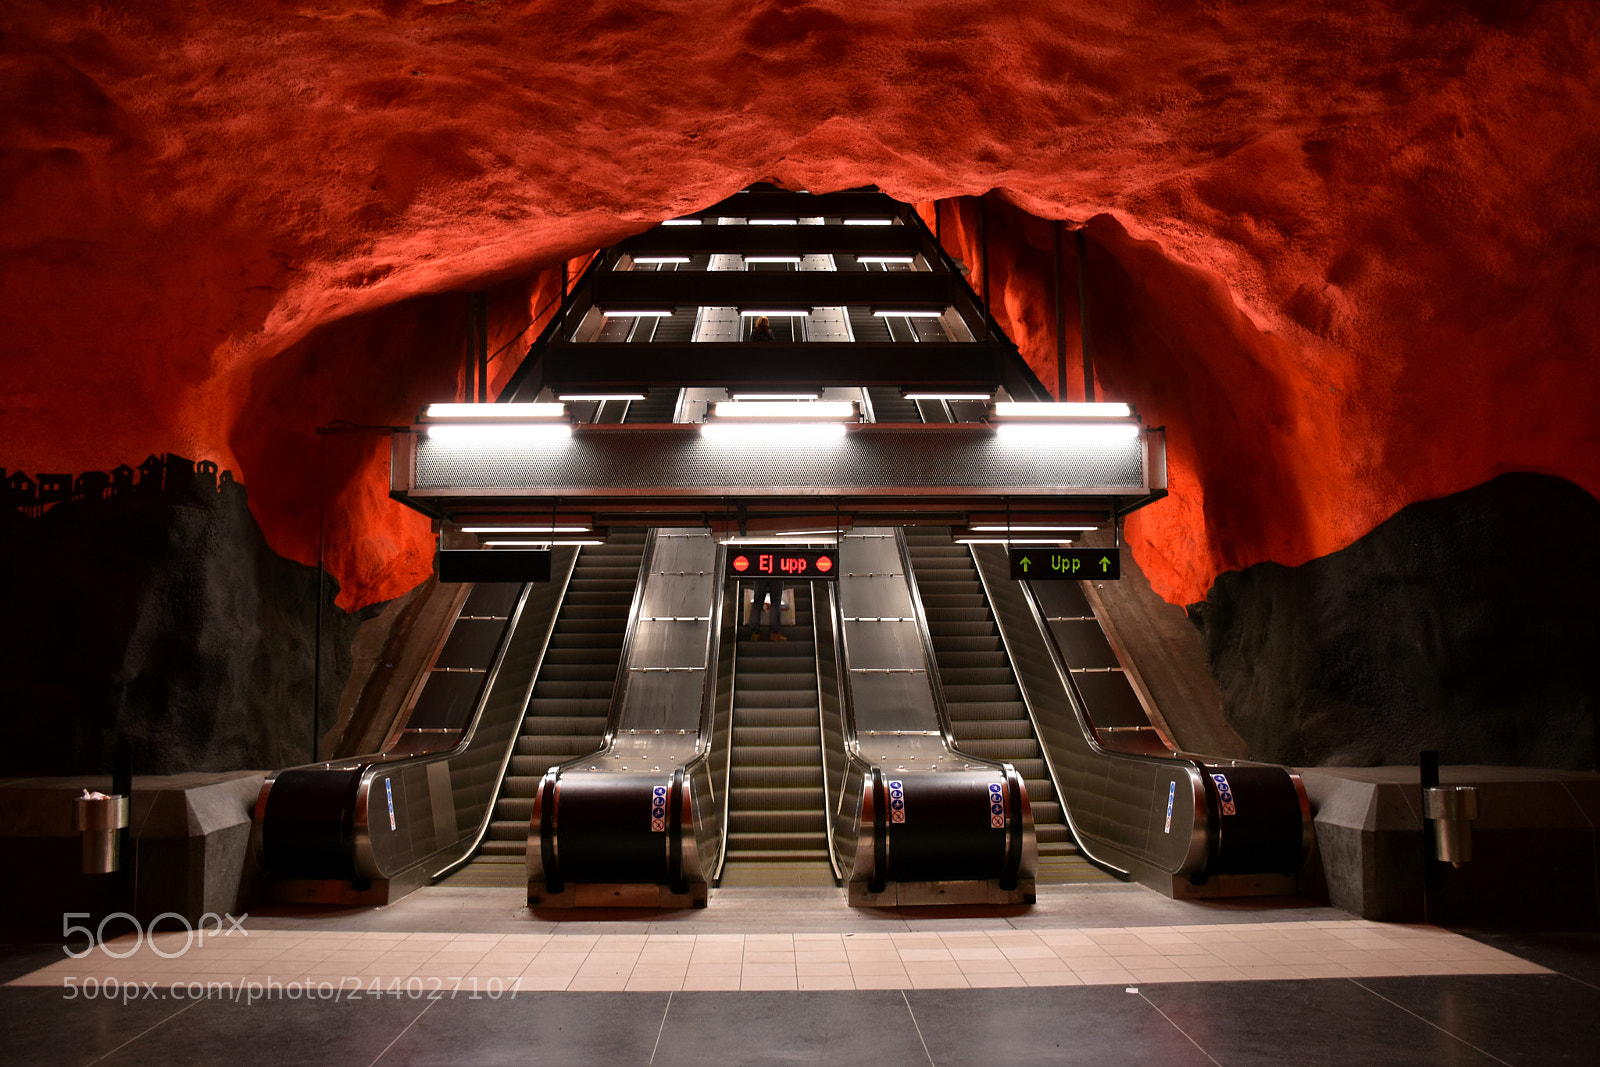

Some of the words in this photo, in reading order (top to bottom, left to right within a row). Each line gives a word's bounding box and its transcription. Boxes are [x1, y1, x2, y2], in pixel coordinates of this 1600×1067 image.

[759, 554, 774, 574] Ej
[780, 558, 807, 574] upp
[1051, 554, 1081, 574] Upp
